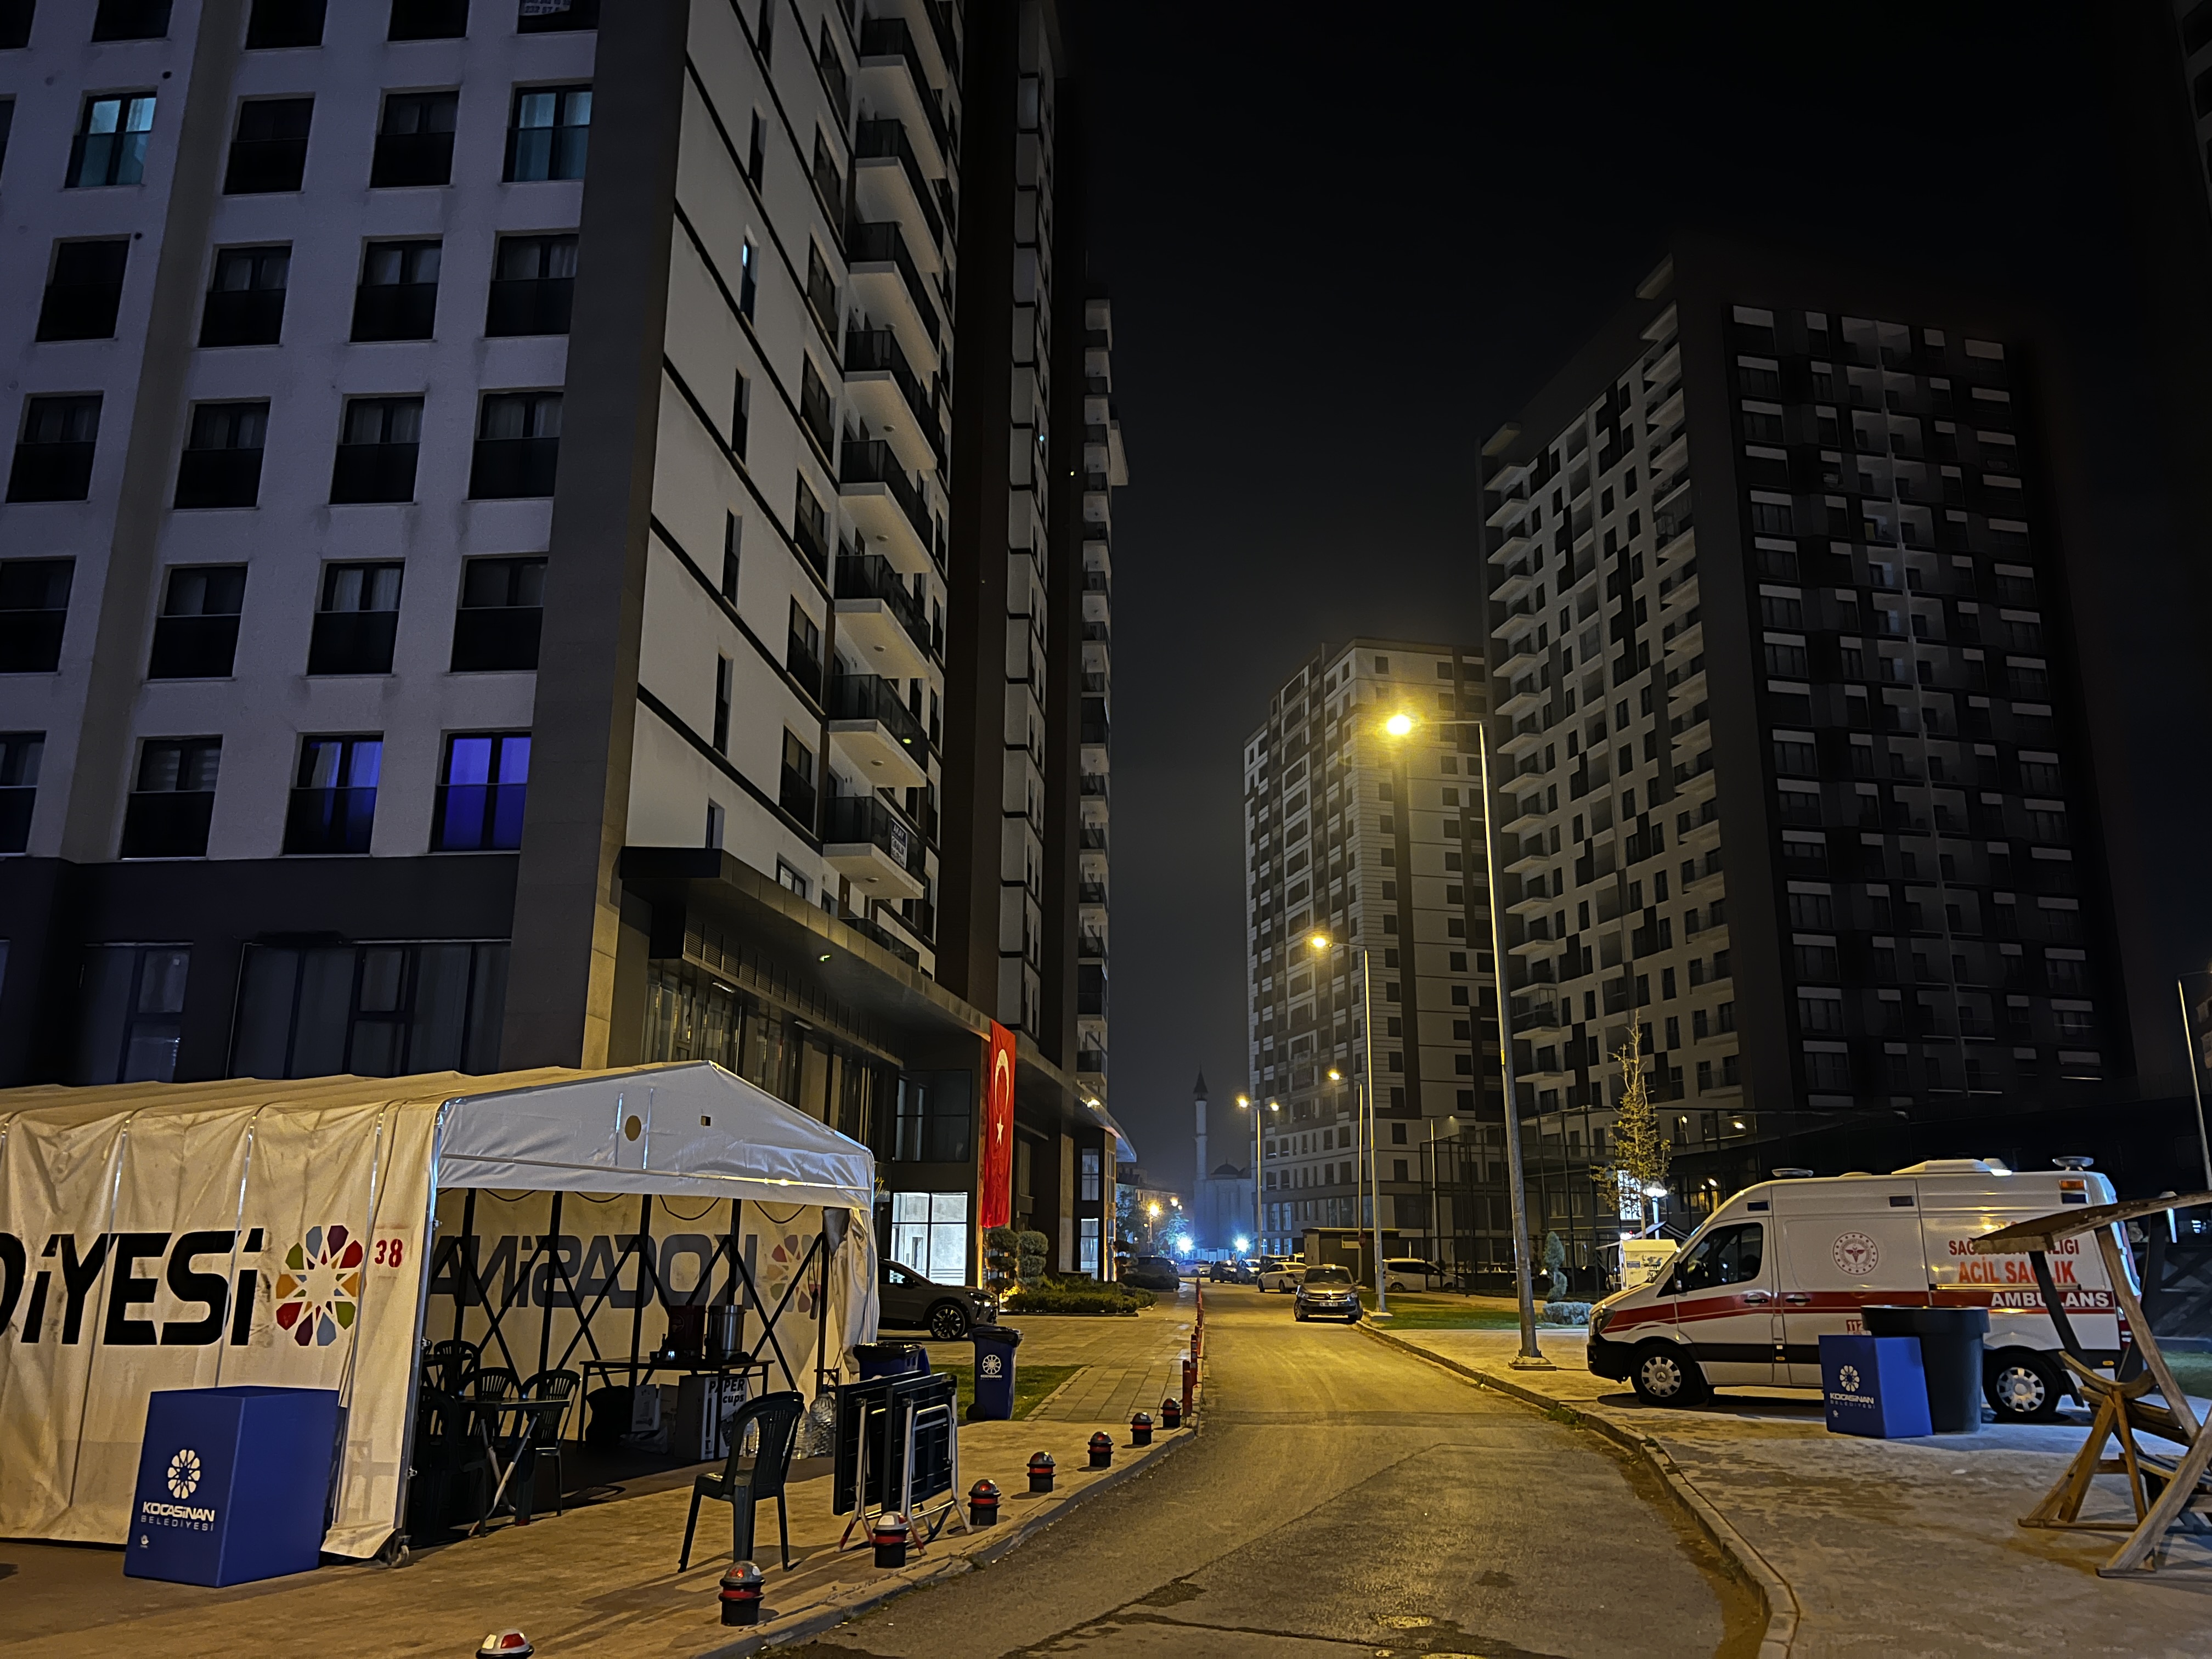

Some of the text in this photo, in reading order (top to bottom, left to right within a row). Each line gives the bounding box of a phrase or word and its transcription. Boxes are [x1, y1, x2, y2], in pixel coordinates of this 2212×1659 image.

[375, 1239, 403, 1267] 38
[1959, 1256, 2076, 1283] ACİL SAIK
[1991, 1292, 2109, 1307] AMBUANS
[1848, 1321, 1864, 1331] 112
[709, 1379, 745, 1393] PPER
[723, 1395, 744, 1406] cups
[140, 1515, 214, 1531] BELEDİYESİ
